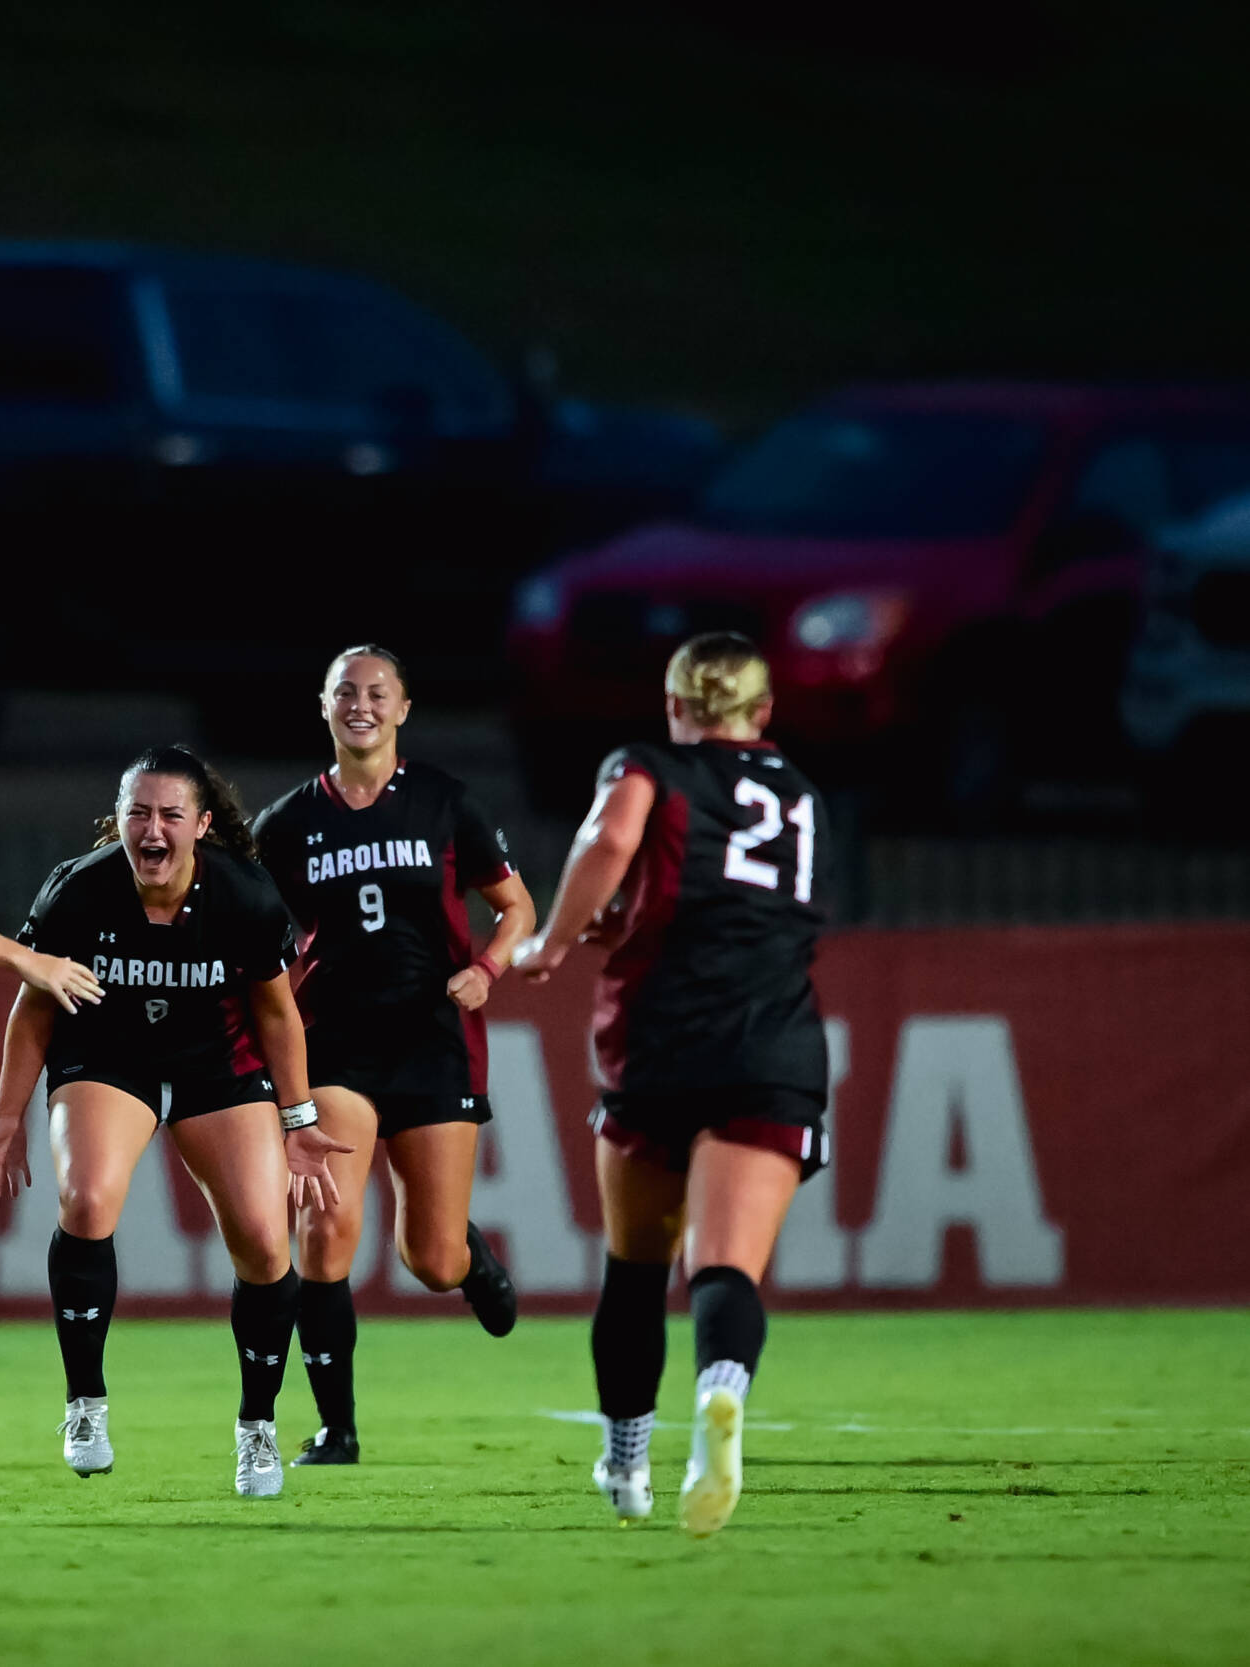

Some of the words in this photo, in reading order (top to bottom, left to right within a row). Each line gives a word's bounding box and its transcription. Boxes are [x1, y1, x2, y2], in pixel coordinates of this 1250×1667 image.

[307, 839, 433, 884] CAROLINA
[724, 776, 815, 903] 21
[358, 883, 385, 933] 9
[93, 954, 226, 988] CAROLINA
